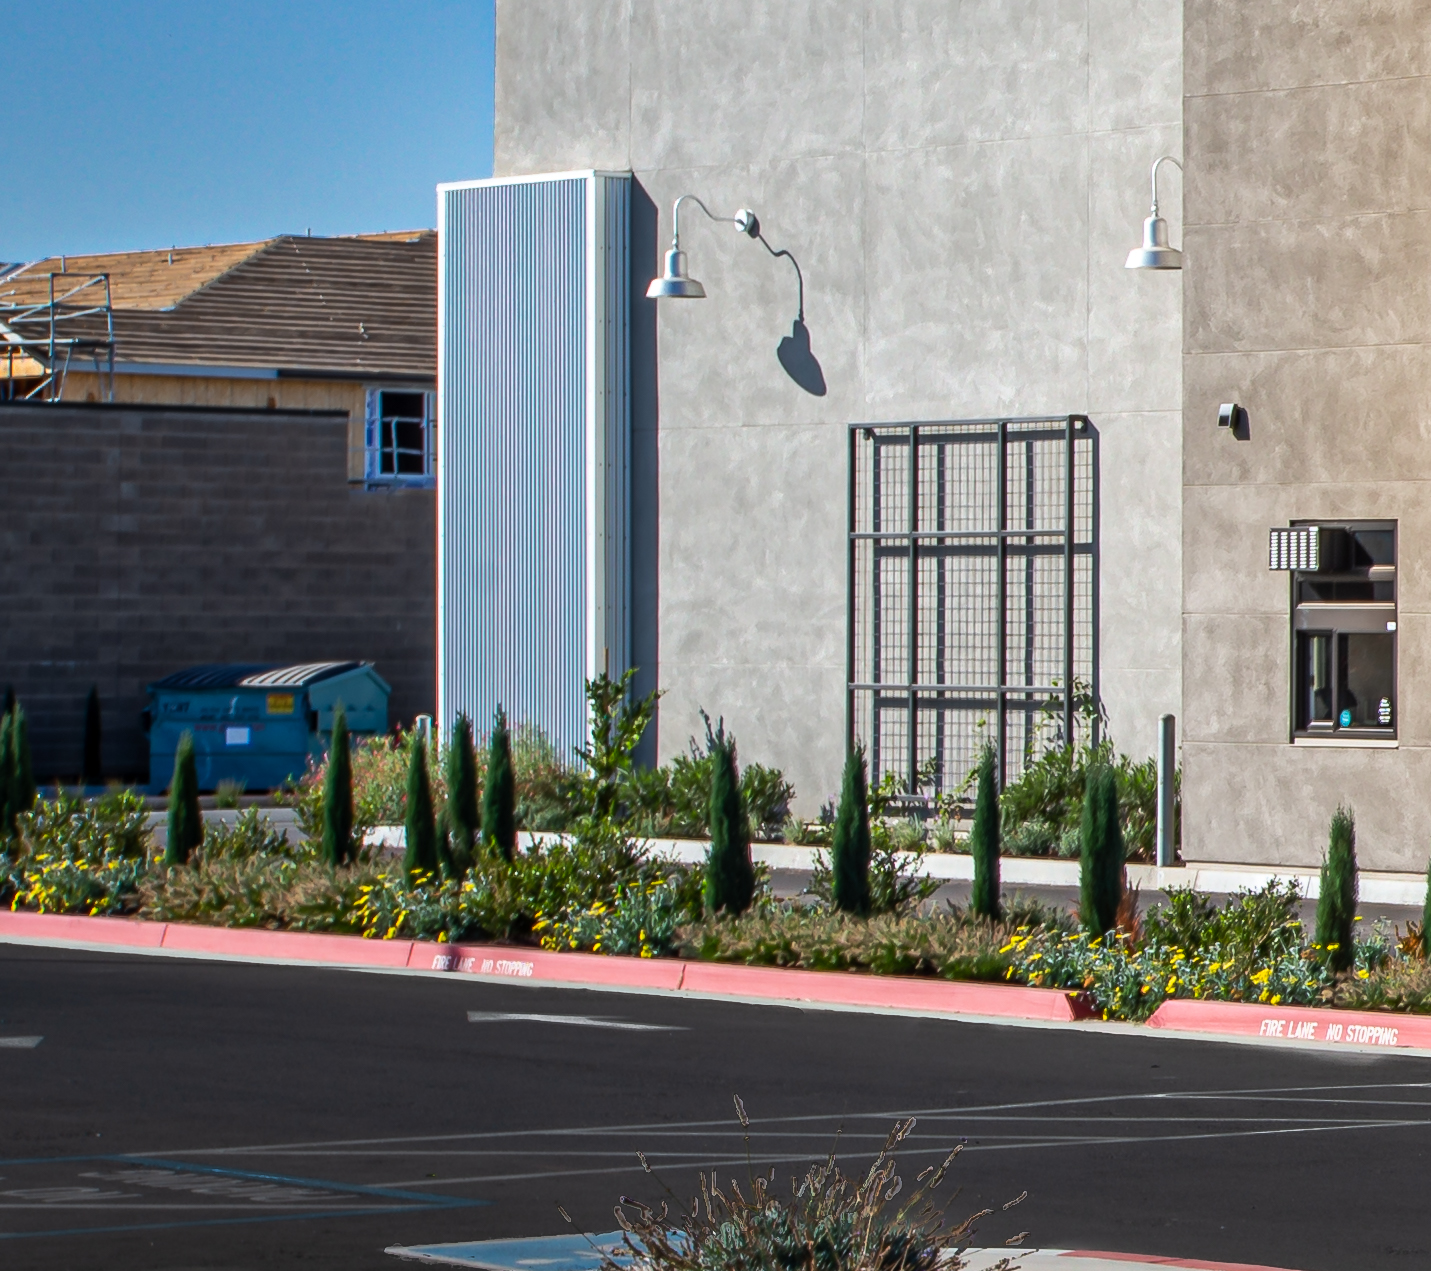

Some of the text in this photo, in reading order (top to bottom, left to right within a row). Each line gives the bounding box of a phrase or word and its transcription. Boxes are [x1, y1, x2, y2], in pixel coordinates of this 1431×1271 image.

[431, 954, 452, 971] FIRE
[480, 958, 494, 975] NO
[495, 960, 534, 977] STOPPING
[1259, 1019, 1399, 1046] FIRE LANE NO STOPPING
